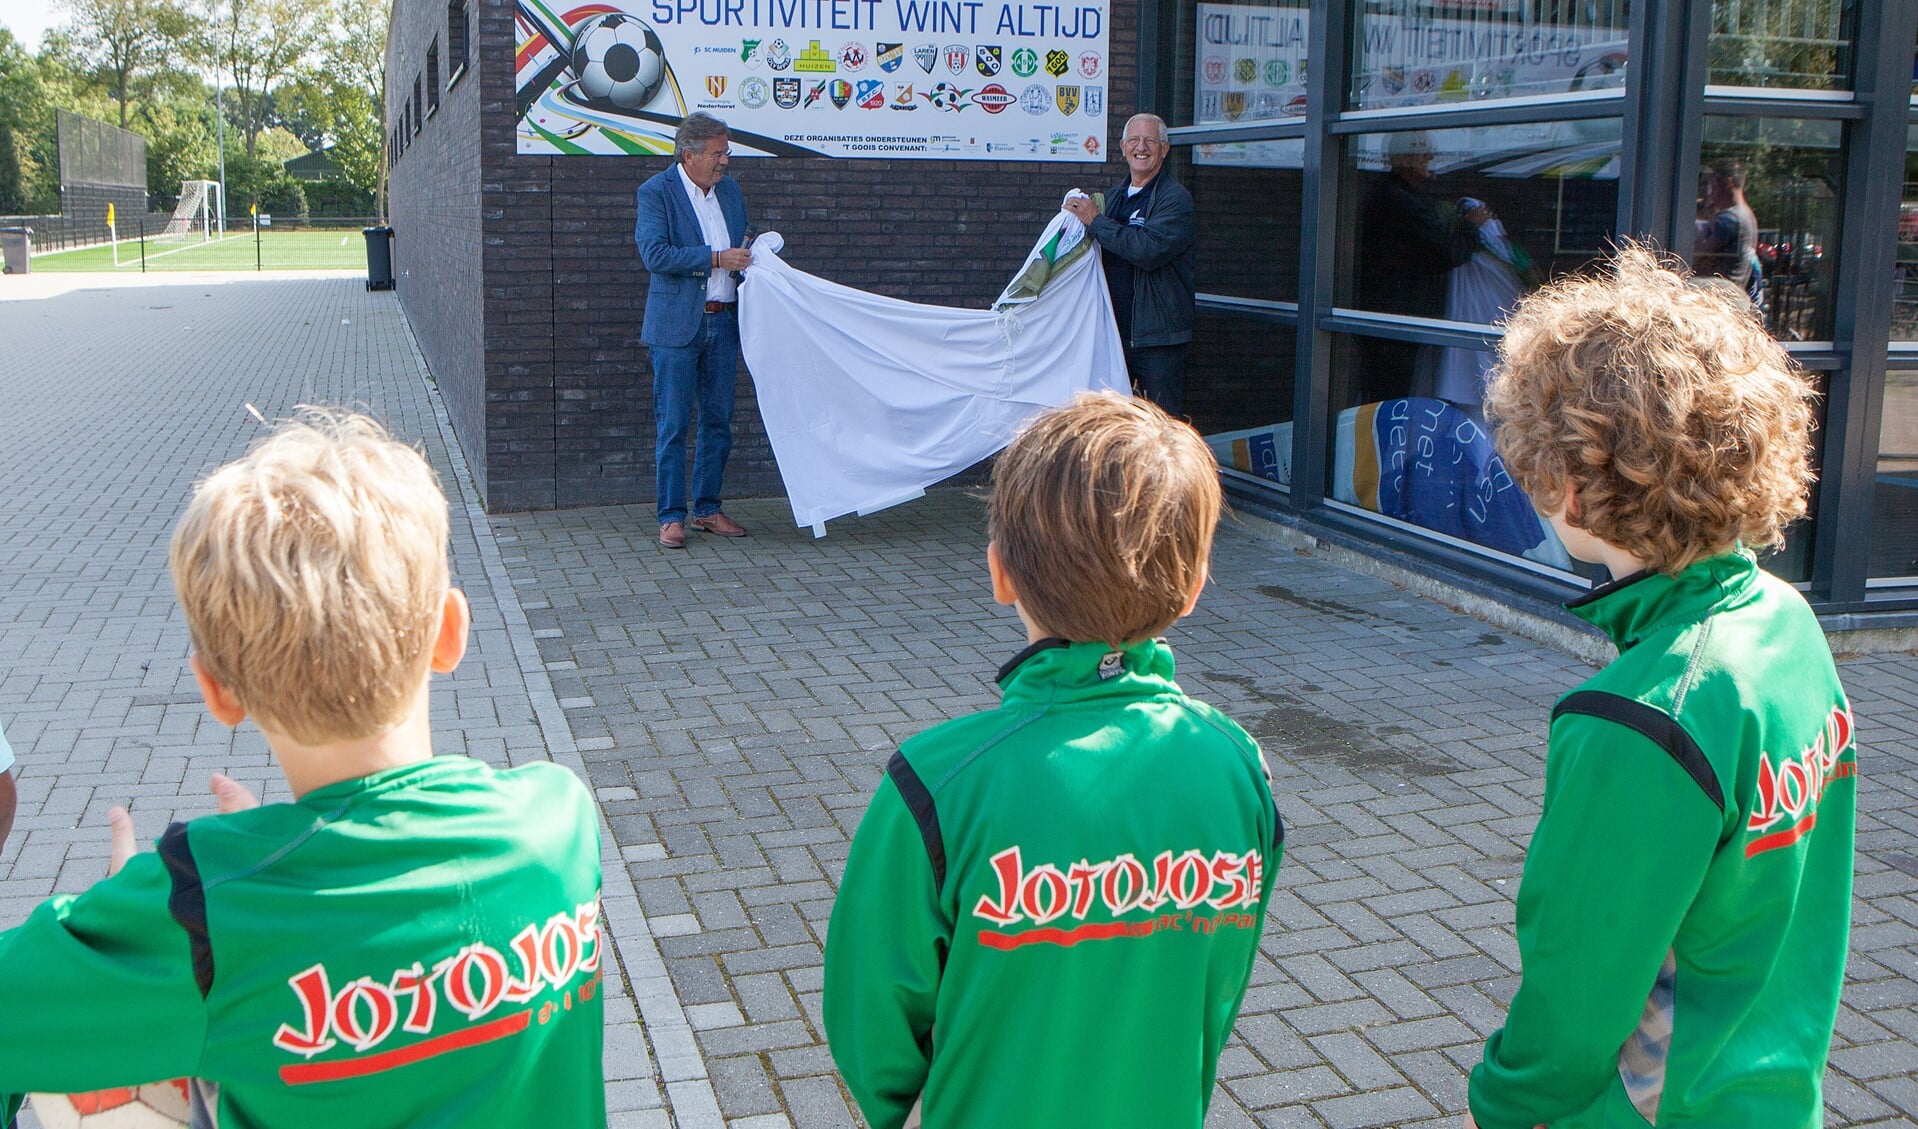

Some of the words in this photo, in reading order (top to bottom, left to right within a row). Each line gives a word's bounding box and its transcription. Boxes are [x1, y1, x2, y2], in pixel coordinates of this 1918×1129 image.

[897, 0, 983, 34] WINT
[996, 4, 1100, 39] ALTIJD
[1059, 87, 1077, 97] BVV
[865, 135, 928, 143] ONDERSTEUNEN
